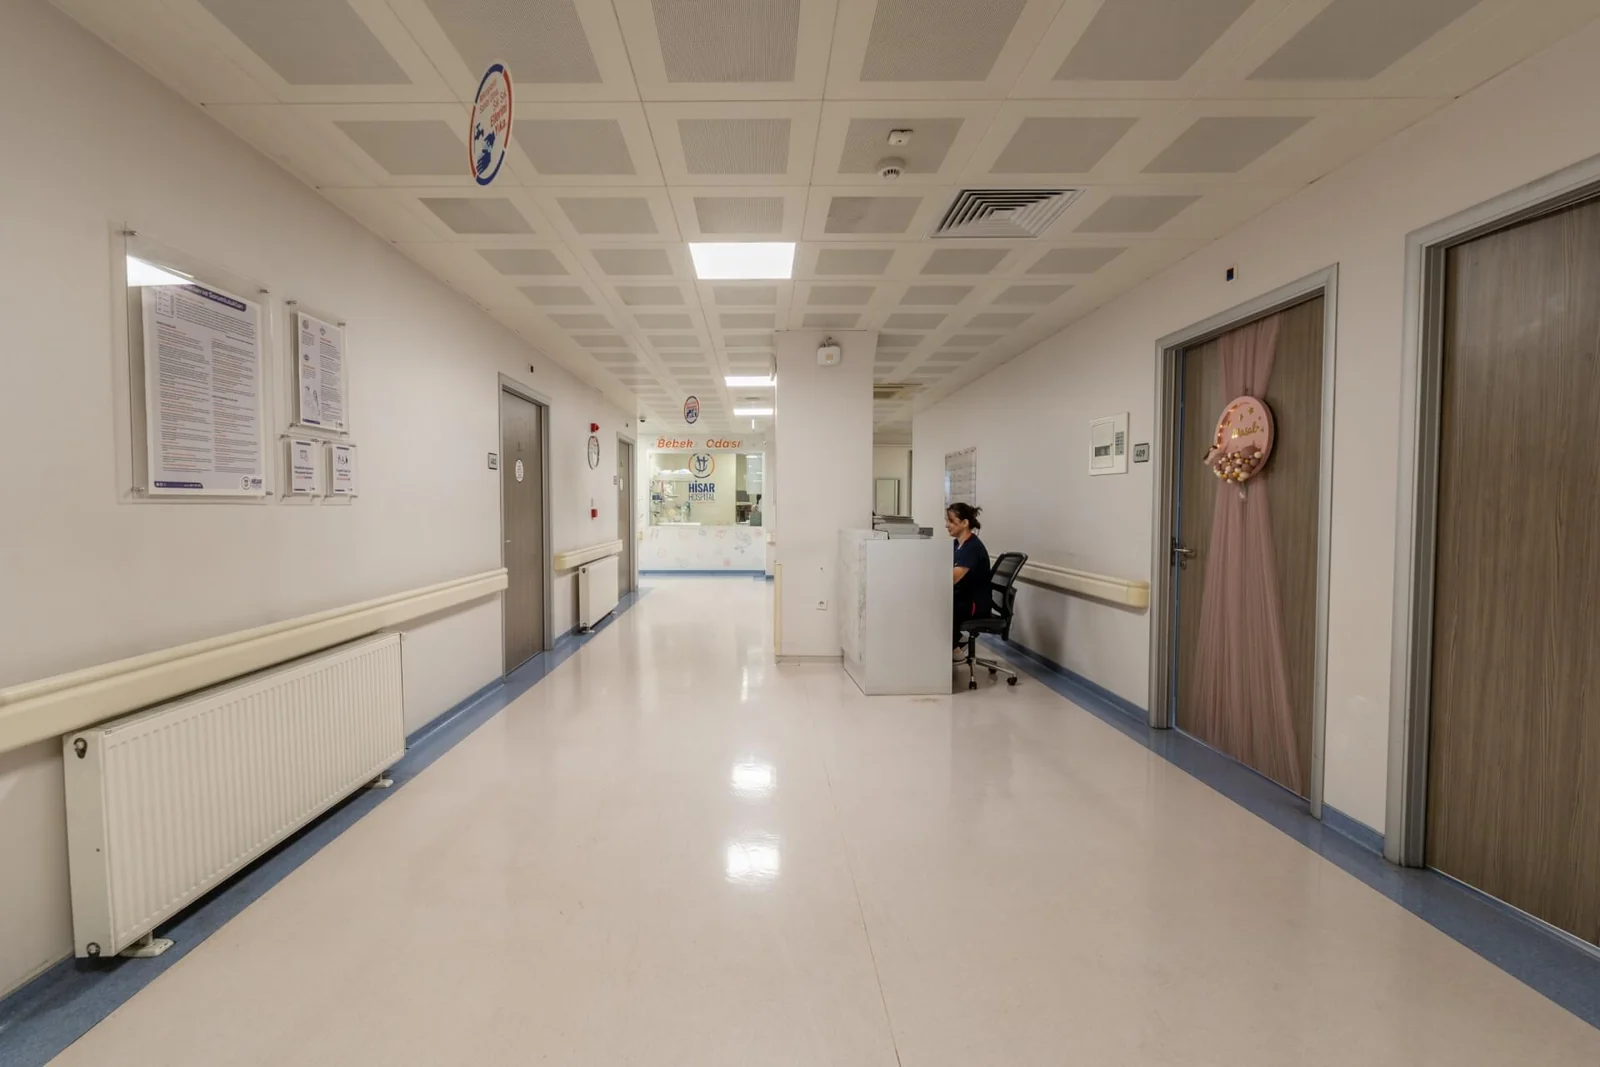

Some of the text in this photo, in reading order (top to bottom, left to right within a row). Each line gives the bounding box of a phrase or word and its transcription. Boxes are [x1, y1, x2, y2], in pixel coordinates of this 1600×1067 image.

[657, 439, 741, 448] Bebek Odası
[688, 480, 715, 493] HİSAR
[688, 493, 715, 501] HOSPITAL
